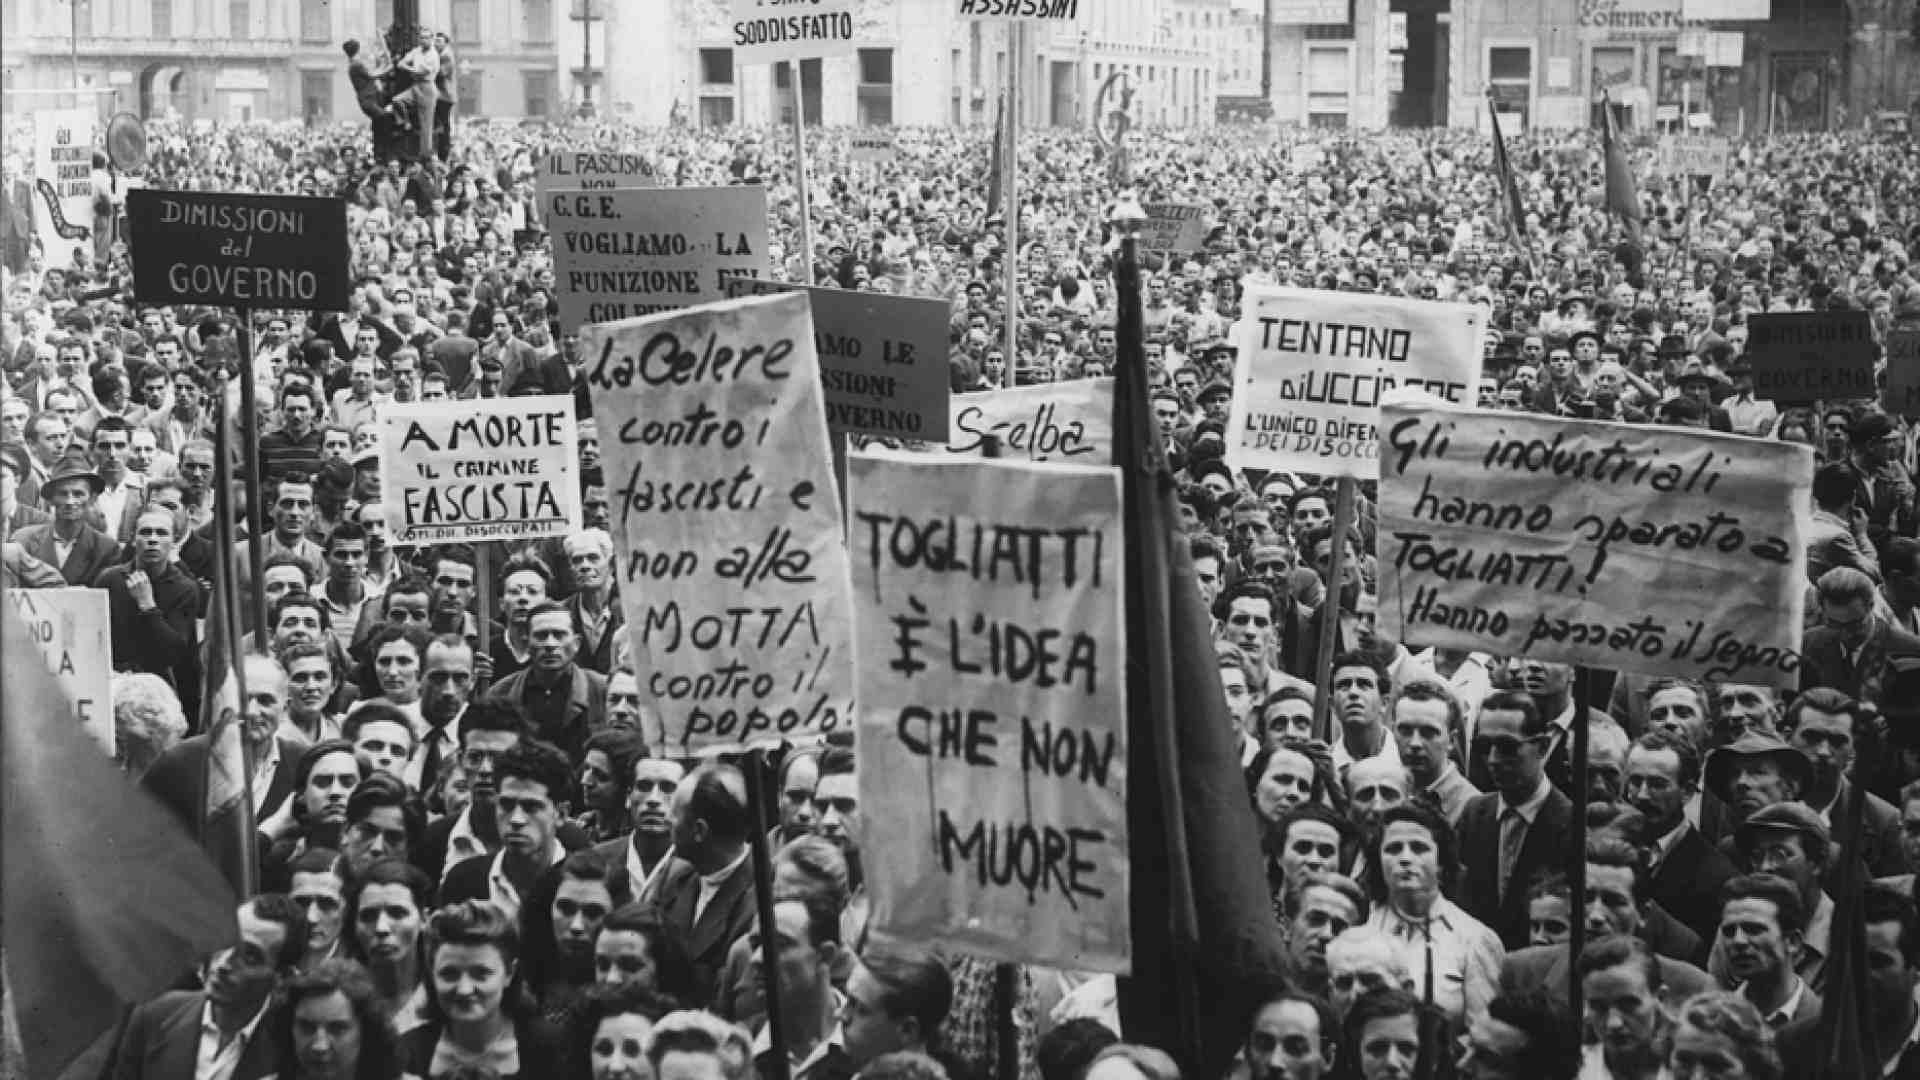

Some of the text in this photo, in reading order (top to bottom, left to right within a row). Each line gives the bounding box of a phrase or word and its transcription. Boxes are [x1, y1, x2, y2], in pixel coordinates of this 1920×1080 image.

[734, 11, 851, 45] SODDISFATTO
[551, 154, 653, 177] IL FASCISMO
[160, 199, 304, 236] DIMISSIONI
[553, 194, 621, 220] C.G.E.
[220, 236, 253, 258] del
[715, 231, 753, 256] LA
[168, 263, 318, 300] GOVERNO
[568, 270, 701, 295] PUNIZIONE
[637, 330, 796, 387] Celere
[882, 339, 916, 366] LE
[1257, 315, 1412, 362] TENTANO
[401, 411, 565, 453] A MORTE
[619, 401, 746, 447] contro
[825, 402, 923, 432] OVERNO
[1254, 431, 1379, 458] DEI DISOCC
[1389, 416, 1732, 495] Gli industriali
[416, 457, 541, 479] IL CRIMINE
[404, 480, 562, 525] FASCISTA
[789, 479, 817, 513] e
[1412, 475, 1791, 565] hanno sparato a
[628, 525, 817, 589] non alla
[856, 509, 1104, 596] TOGLIATTI
[1392, 531, 1609, 597] TOGLIATTI!
[641, 600, 820, 653] MOTTA
[1408, 584, 1510, 638] Hanno
[1521, 614, 1667, 657] passato
[1671, 618, 1704, 660] il
[889, 598, 1097, 696] È L'IDEA
[649, 645, 830, 703] contro il
[680, 693, 855, 746] popolo!
[897, 704, 1115, 789] CHE NON
[938, 810, 1106, 911] MUORE
